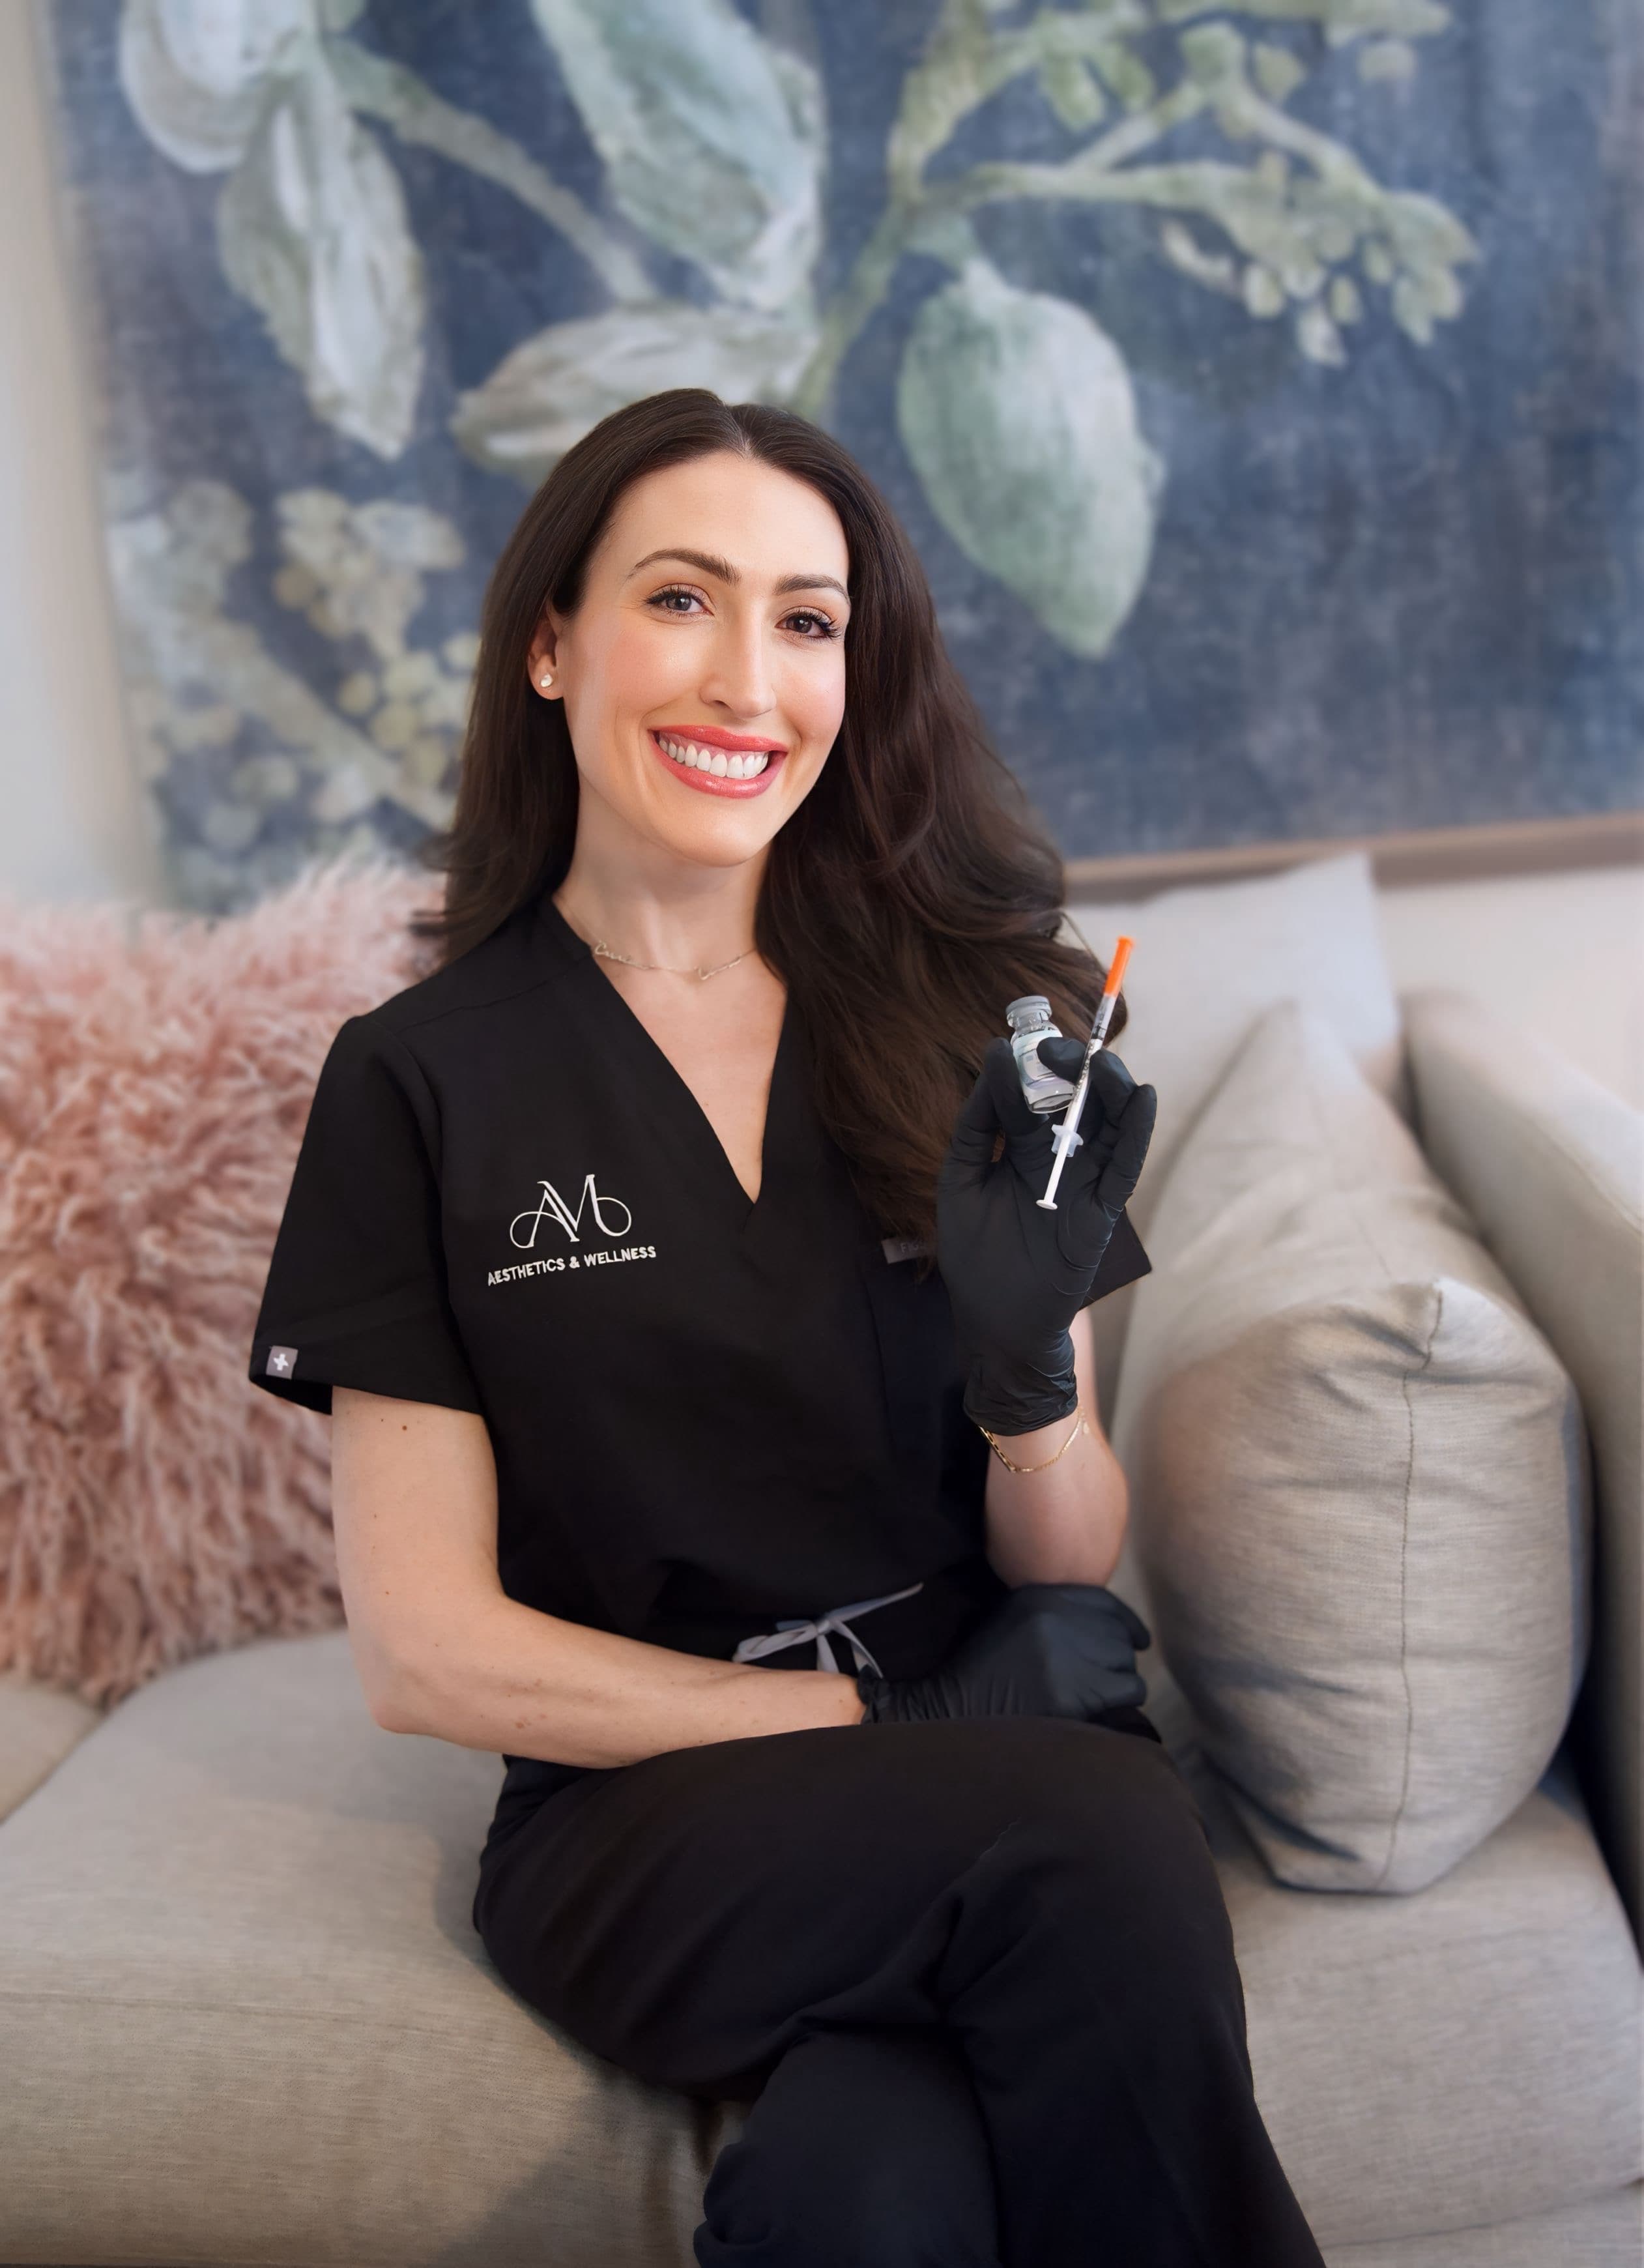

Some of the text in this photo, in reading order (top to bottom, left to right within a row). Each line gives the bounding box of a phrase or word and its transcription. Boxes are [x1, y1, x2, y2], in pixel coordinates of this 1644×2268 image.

[488, 1245, 656, 1287] AESTHETICS & WELLNESS
